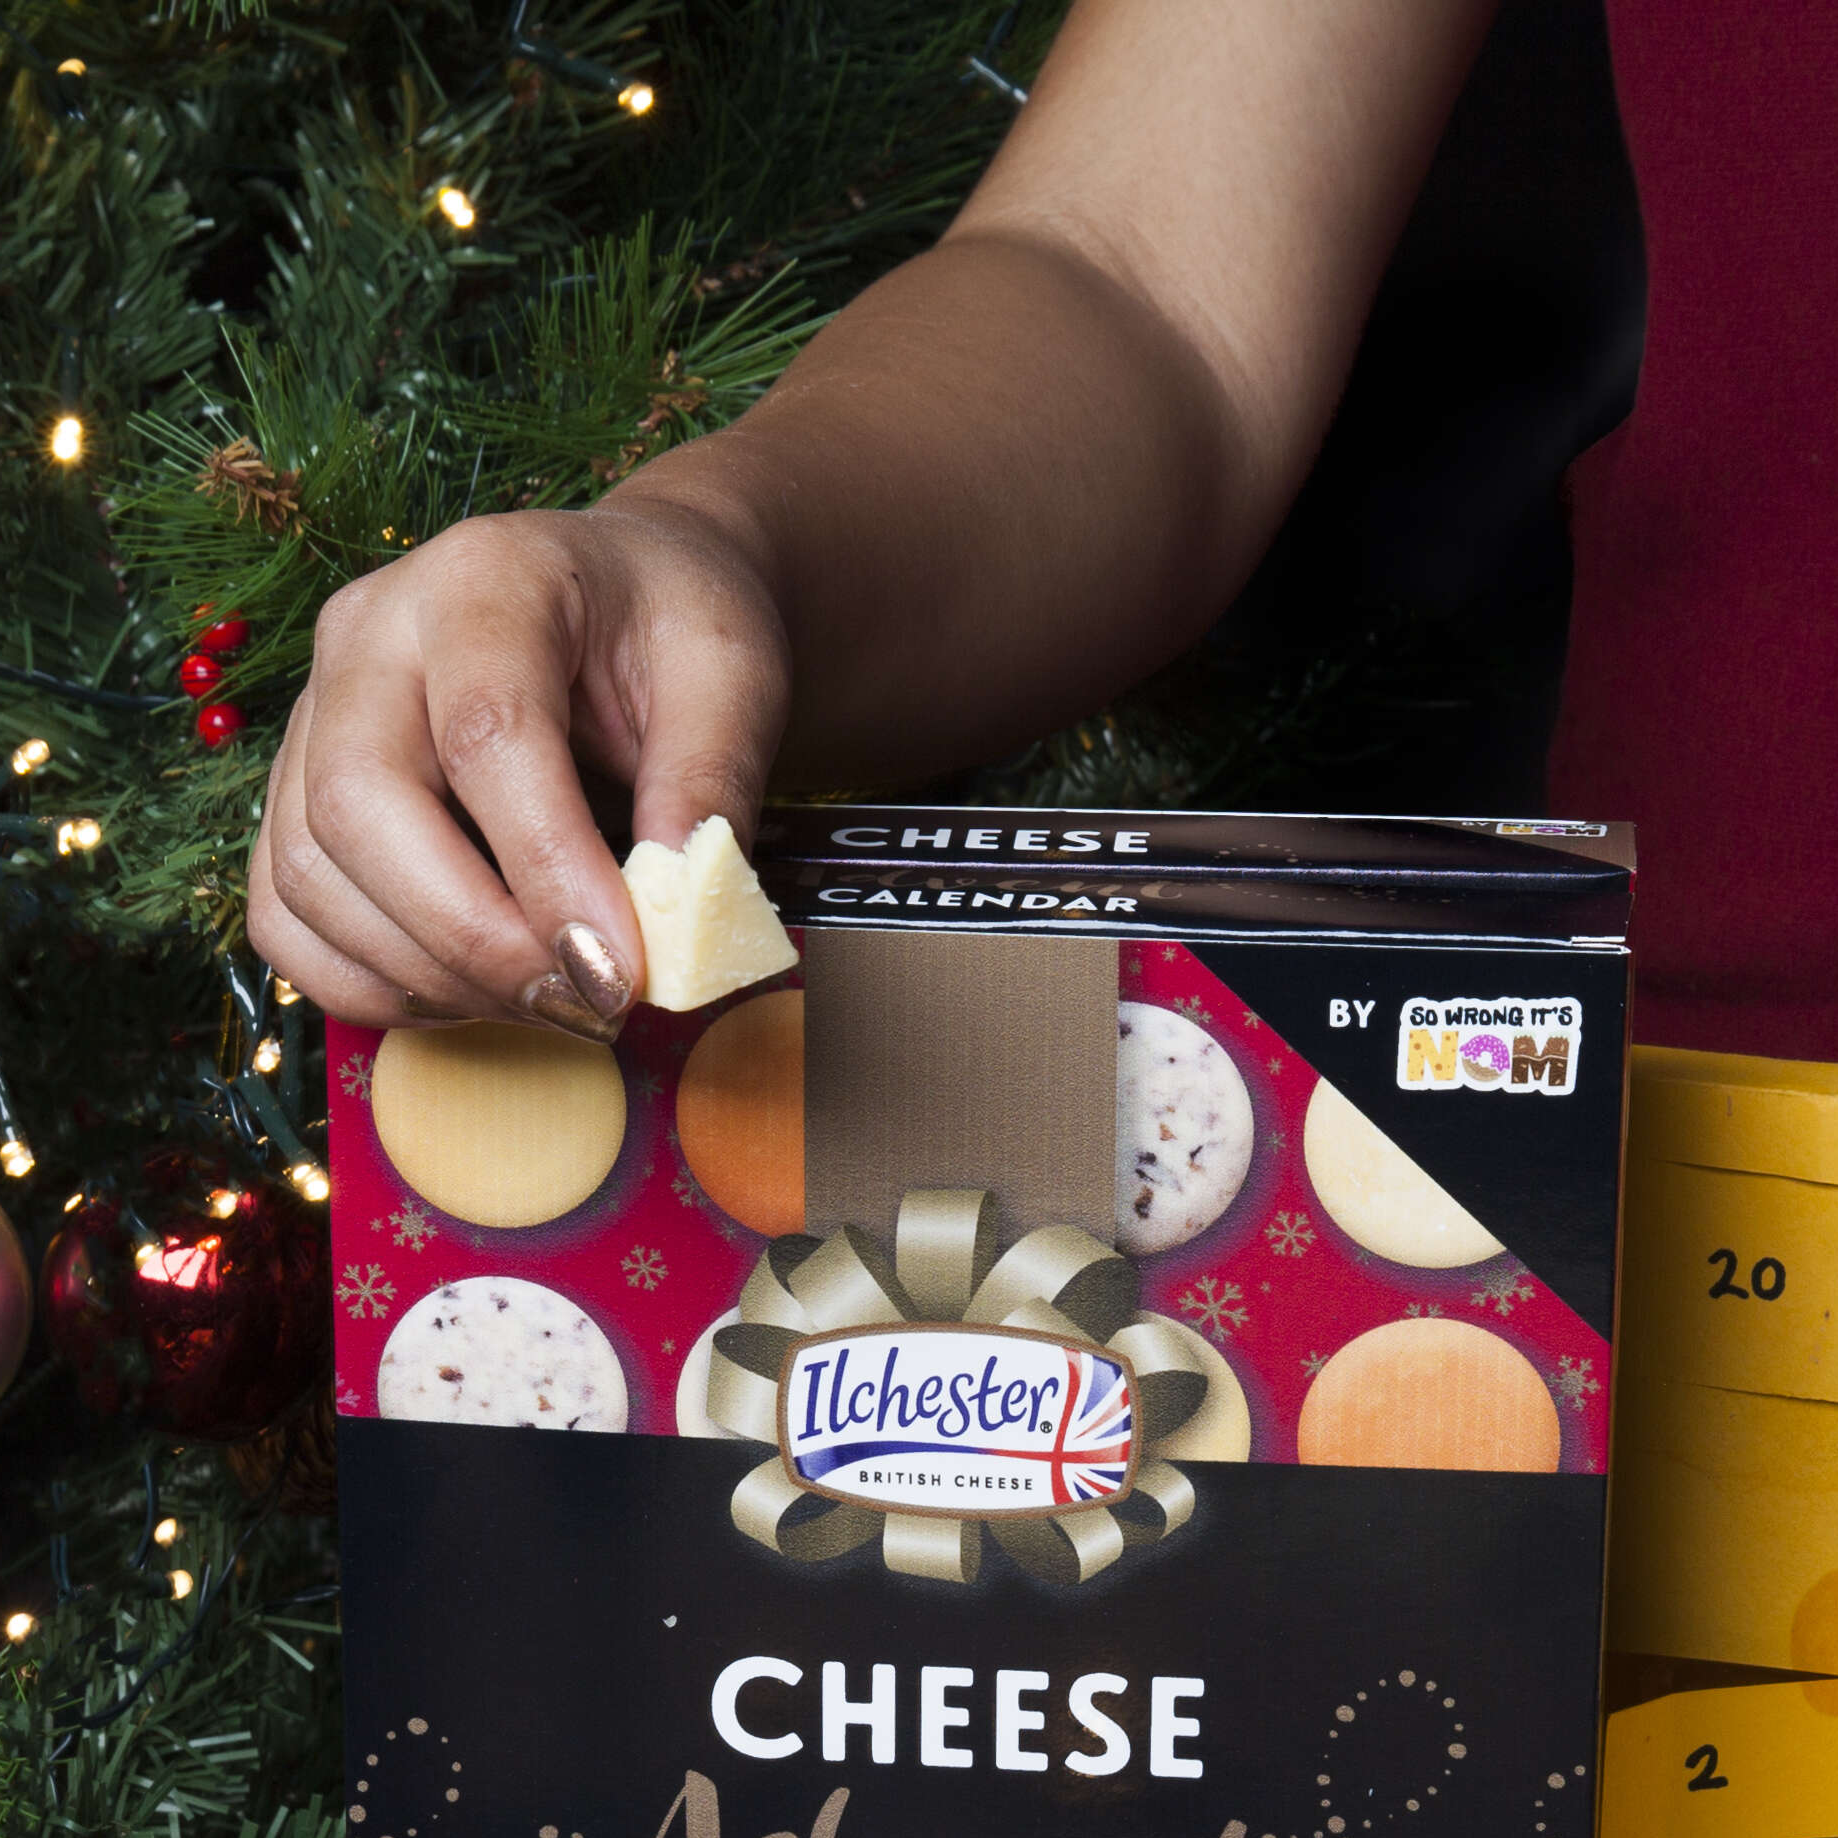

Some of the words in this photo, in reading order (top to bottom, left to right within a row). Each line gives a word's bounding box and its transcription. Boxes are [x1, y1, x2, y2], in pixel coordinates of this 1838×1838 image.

[830, 826, 1152, 853] CHEESE
[818, 888, 1139, 912] CALENDAR
[1329, 998, 1376, 1028] BY
[1409, 1006, 1438, 1026] SO
[1444, 1005, 1525, 1027] WRONG
[1530, 1006, 1573, 1026] IT'S
[1405, 1029, 1571, 1087] NOM
[1707, 1251, 1788, 1303] 20
[859, 1470, 942, 1487] BRITISH
[954, 1475, 1034, 1491] CHEESE
[711, 1656, 1205, 1779] CHEESE
[1683, 1743, 1730, 1794] 2
